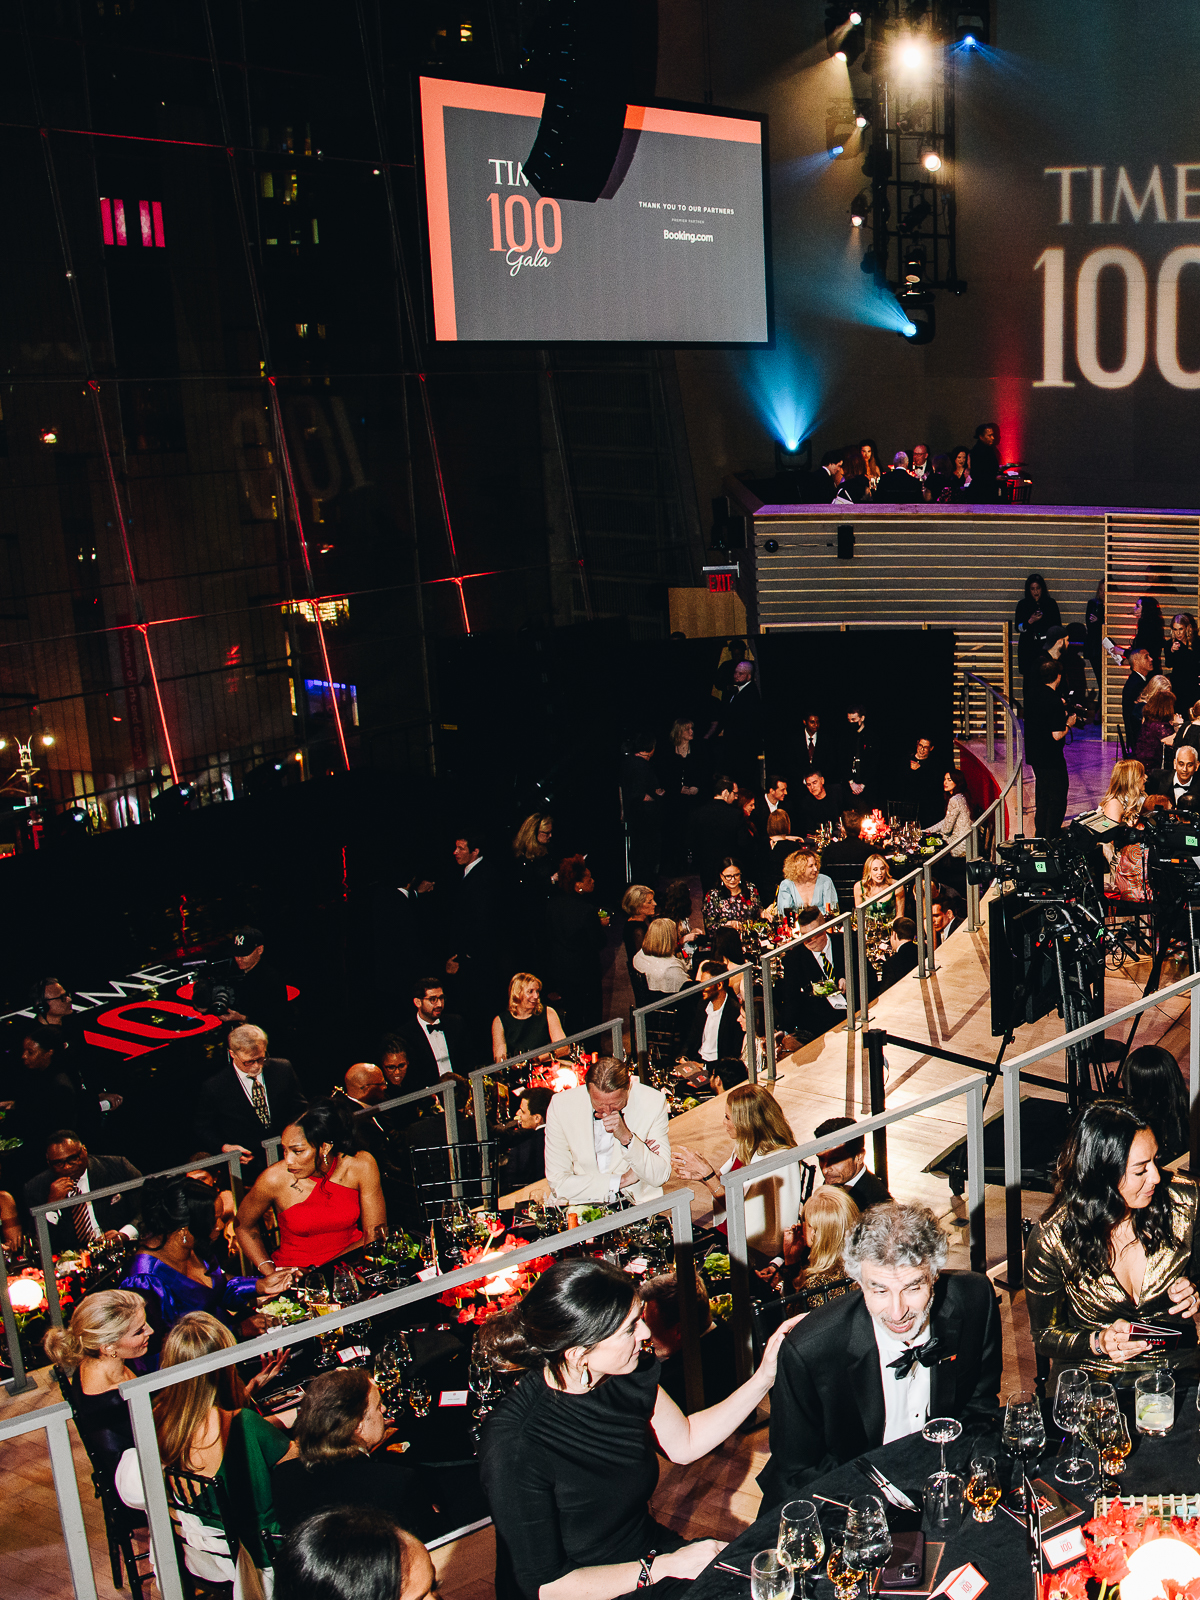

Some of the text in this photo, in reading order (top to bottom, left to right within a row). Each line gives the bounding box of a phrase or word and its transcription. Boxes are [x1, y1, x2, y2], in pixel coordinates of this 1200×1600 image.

[639, 201, 660, 209] THANK
[703, 207, 734, 215] PARTNERS
[486, 192, 562, 254] 100
[663, 229, 713, 243] Booking.com
[506, 247, 551, 276] Gala
[709, 574, 732, 592] EXIT
[1060, 1542, 1072, 1552] 100
[961, 1581, 972, 1593] 100
